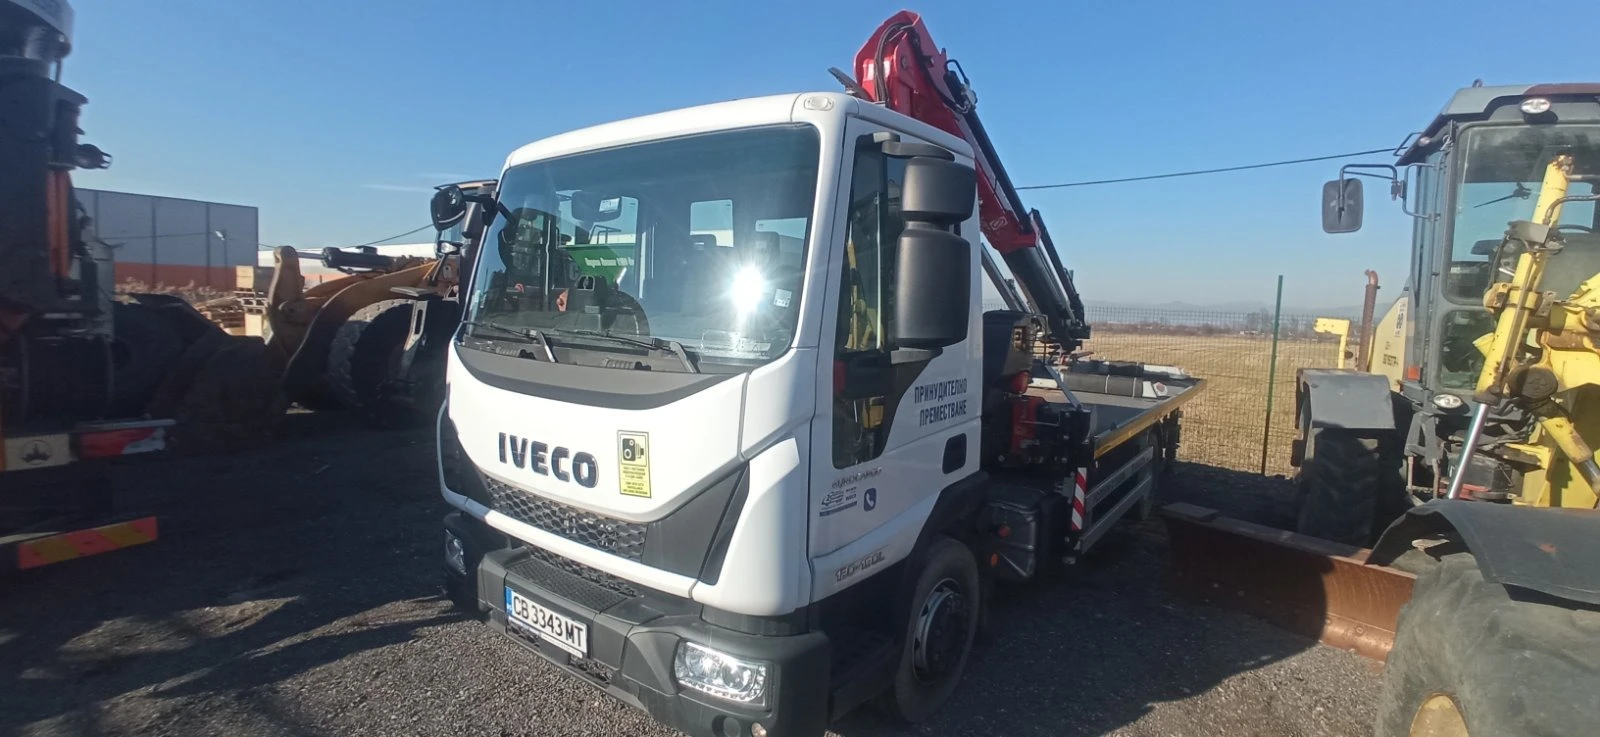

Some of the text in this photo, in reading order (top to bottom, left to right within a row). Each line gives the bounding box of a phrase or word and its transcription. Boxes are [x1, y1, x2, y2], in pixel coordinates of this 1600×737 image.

[914, 378, 967, 404] ПРИНУДИТЕЛНО
[919, 400, 967, 426] ПРЕМЕСТВАНЕ
[498, 431, 600, 489] IVECO
[513, 596, 529, 620] CB
[531, 604, 563, 637] 3343
[565, 620, 584, 648] MT
